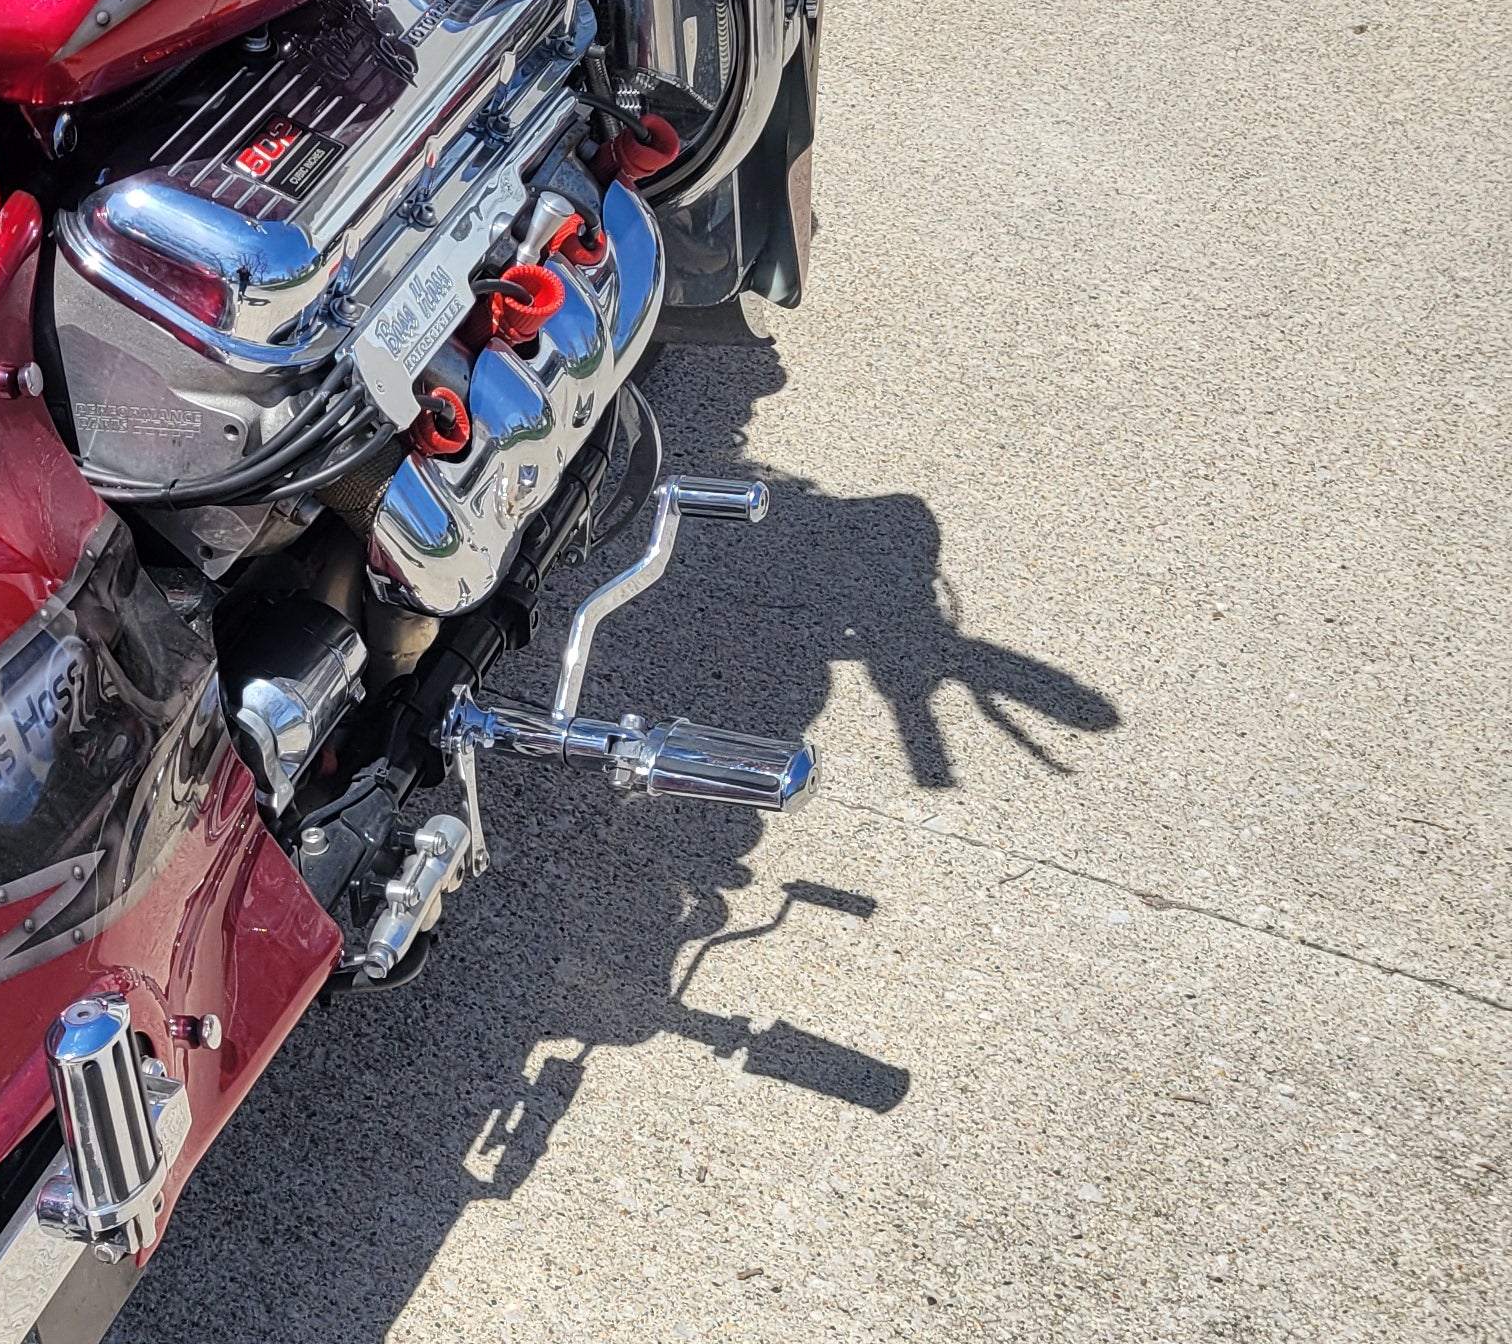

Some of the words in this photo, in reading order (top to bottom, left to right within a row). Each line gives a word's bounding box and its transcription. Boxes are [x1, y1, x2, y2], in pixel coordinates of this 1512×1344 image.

[235, 121, 303, 177] 502
[74, 402, 203, 425] PERFORMANCE
[77, 416, 128, 433] PARTS
